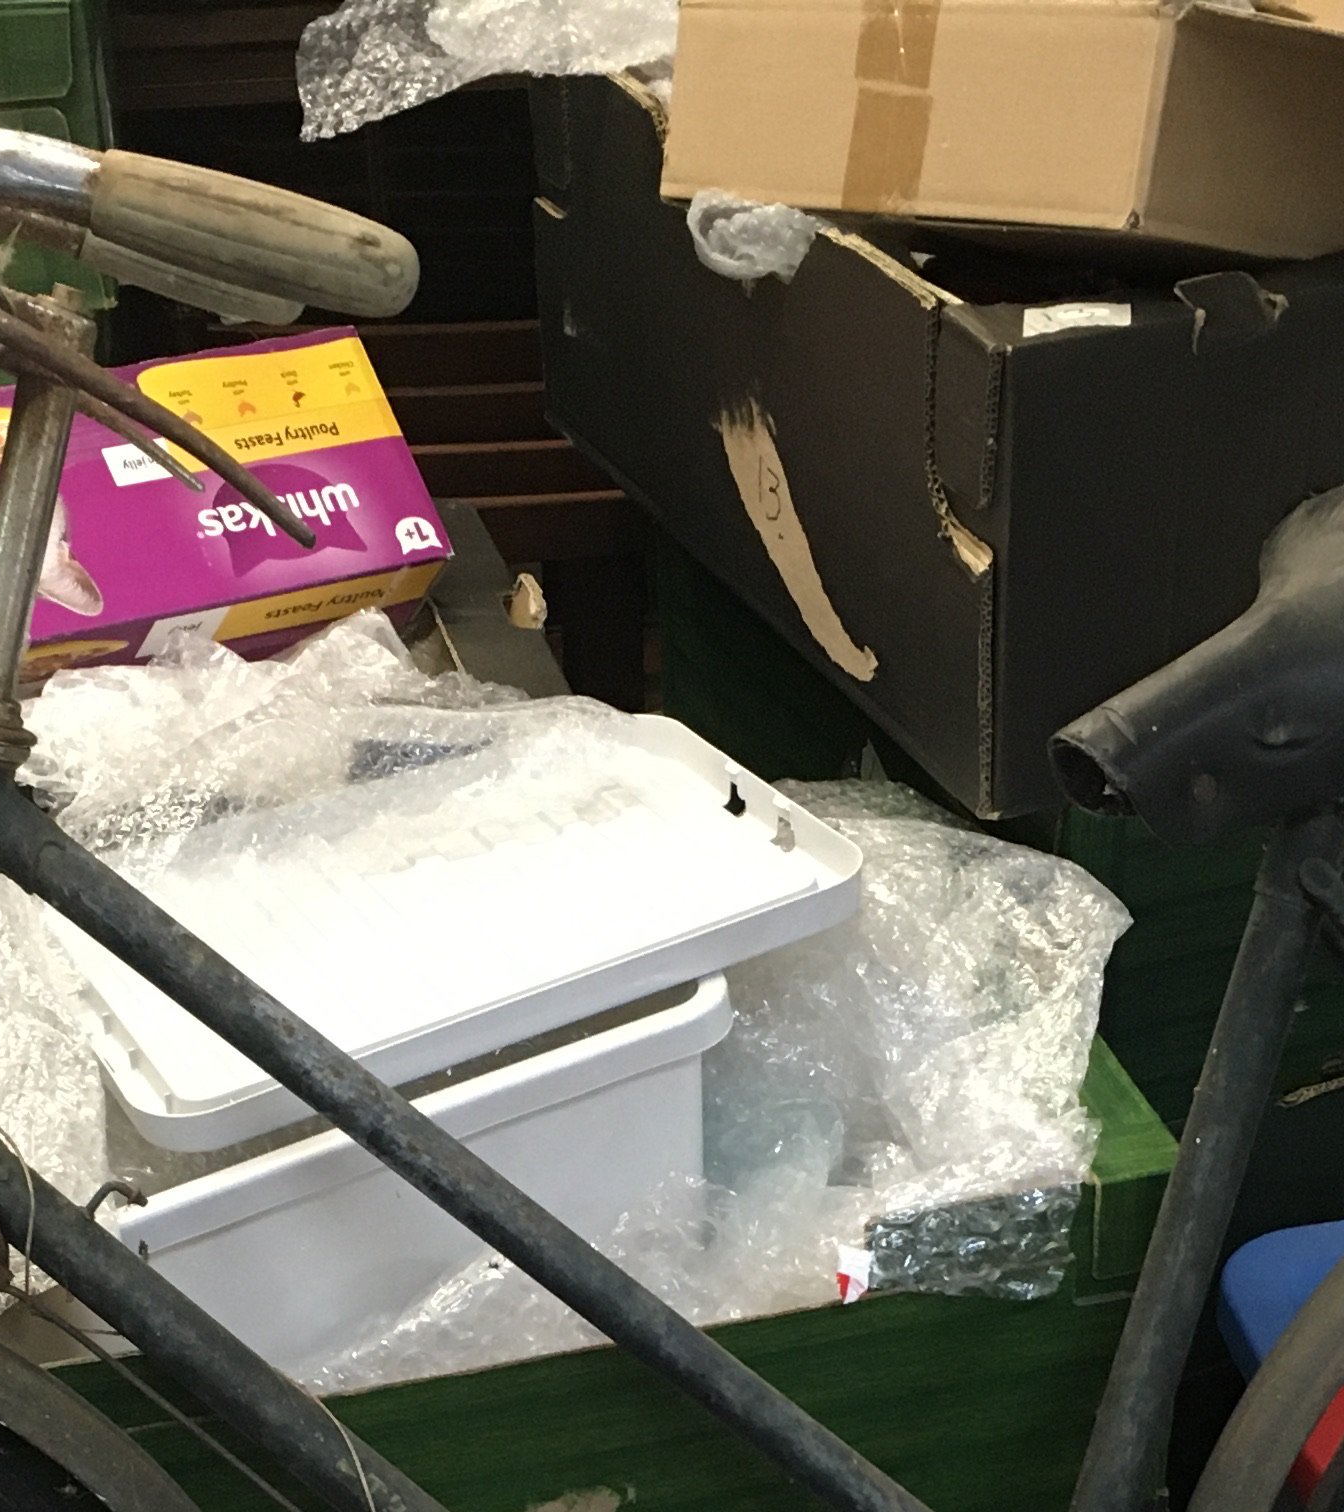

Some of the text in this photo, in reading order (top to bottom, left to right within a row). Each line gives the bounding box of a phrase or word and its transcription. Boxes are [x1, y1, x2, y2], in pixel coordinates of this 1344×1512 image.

[234, 421, 340, 450] Poultry Feasts
[122, 457, 146, 470] jelly
[197, 483, 360, 537] whikas
[404, 521, 431, 542] 1+
[264, 600, 323, 620] Feasts
